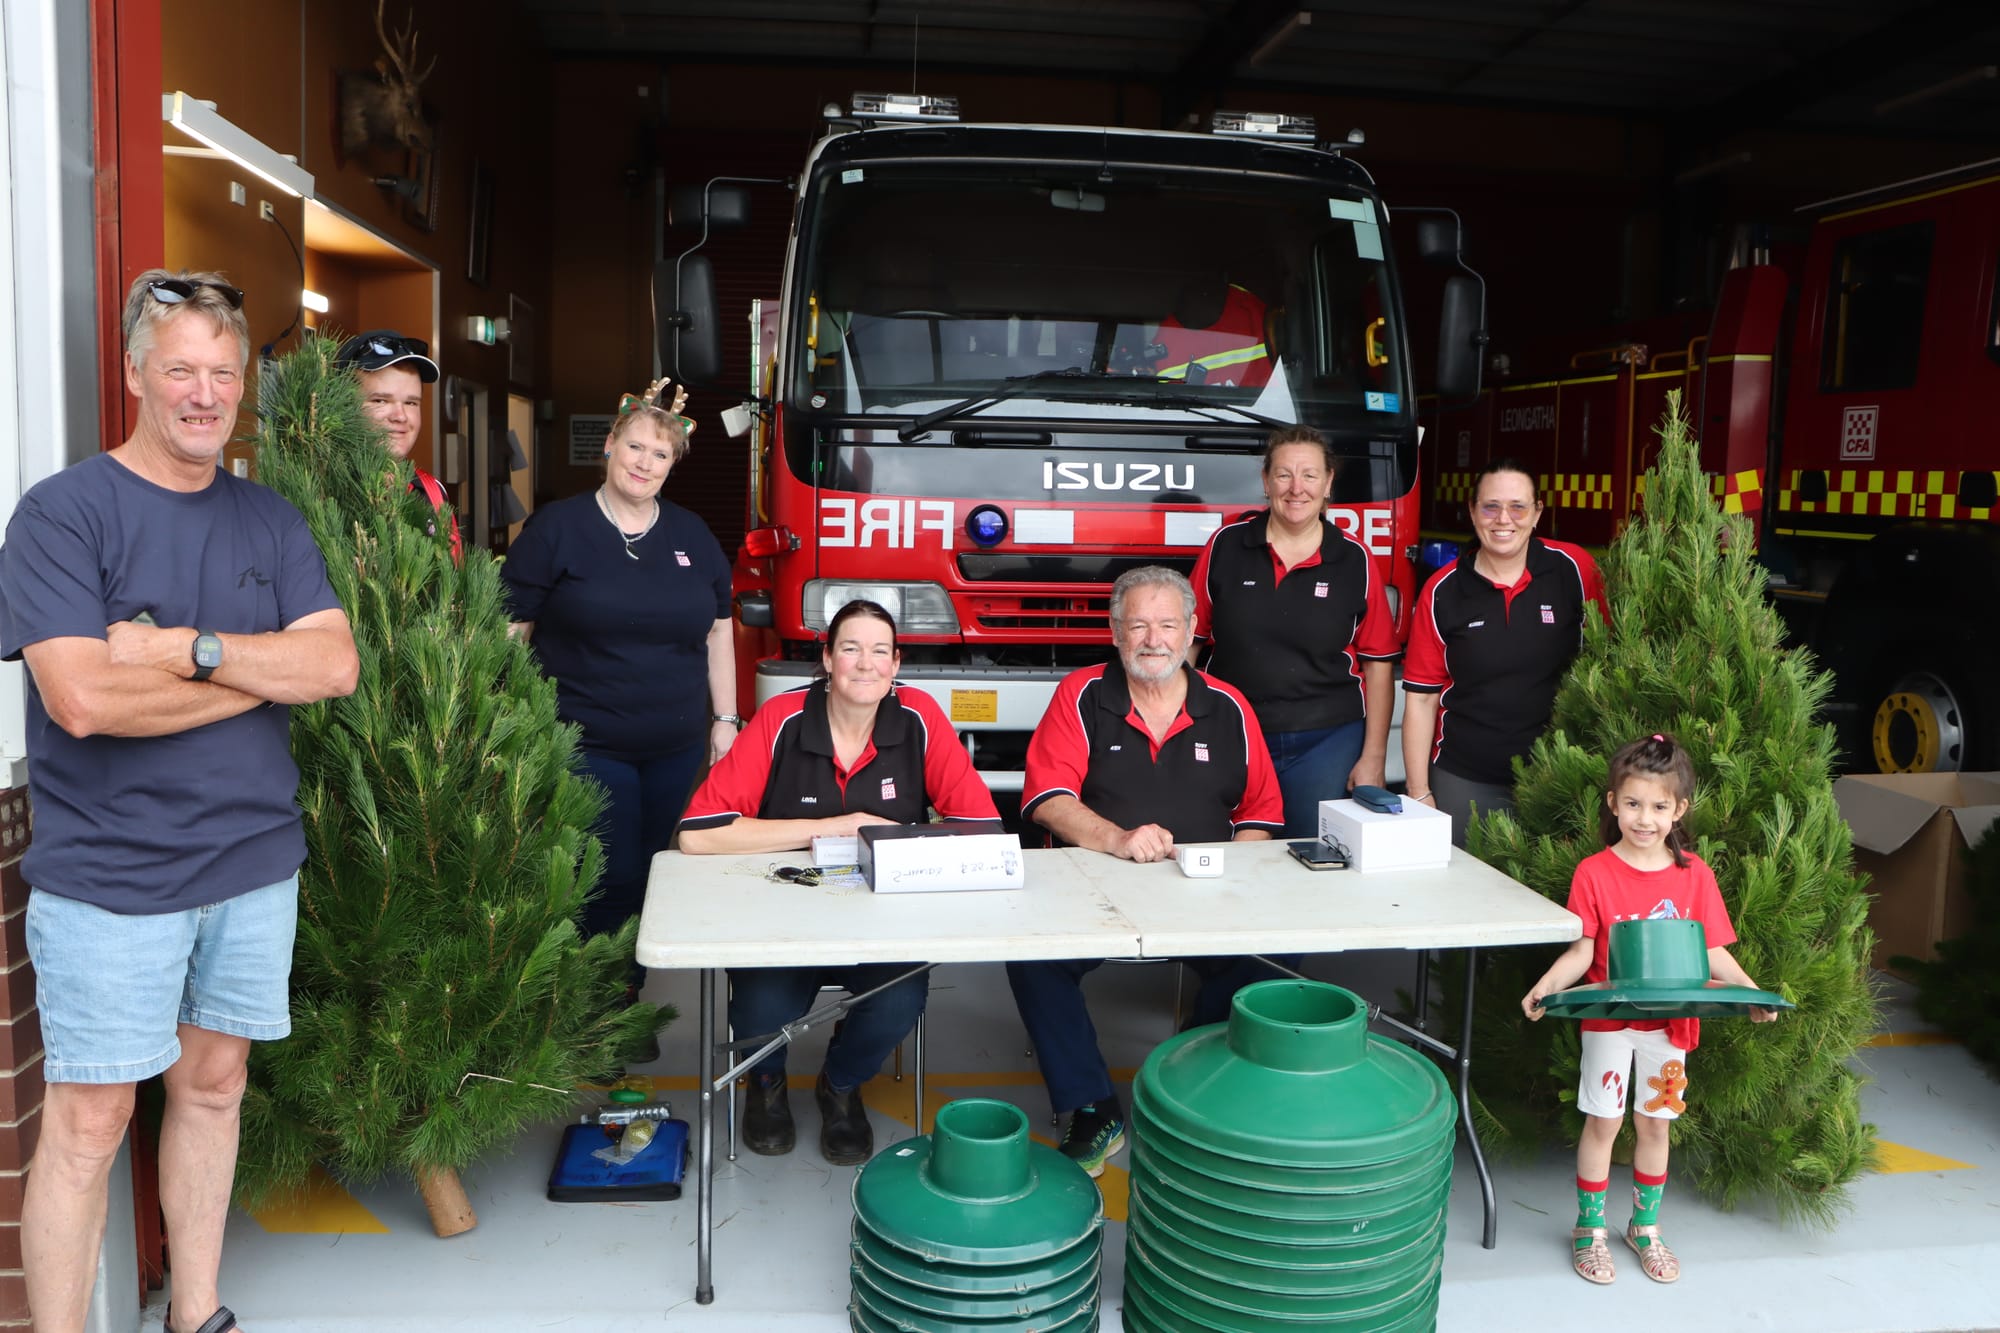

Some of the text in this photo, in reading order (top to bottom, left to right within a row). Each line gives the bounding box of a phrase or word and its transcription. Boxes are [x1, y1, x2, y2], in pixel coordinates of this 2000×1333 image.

[1500, 405, 1555, 432] LEONGATHA
[1846, 438, 1870, 453] CFA
[1043, 461, 1195, 491] ISUZU
[1325, 508, 1392, 556] RE
